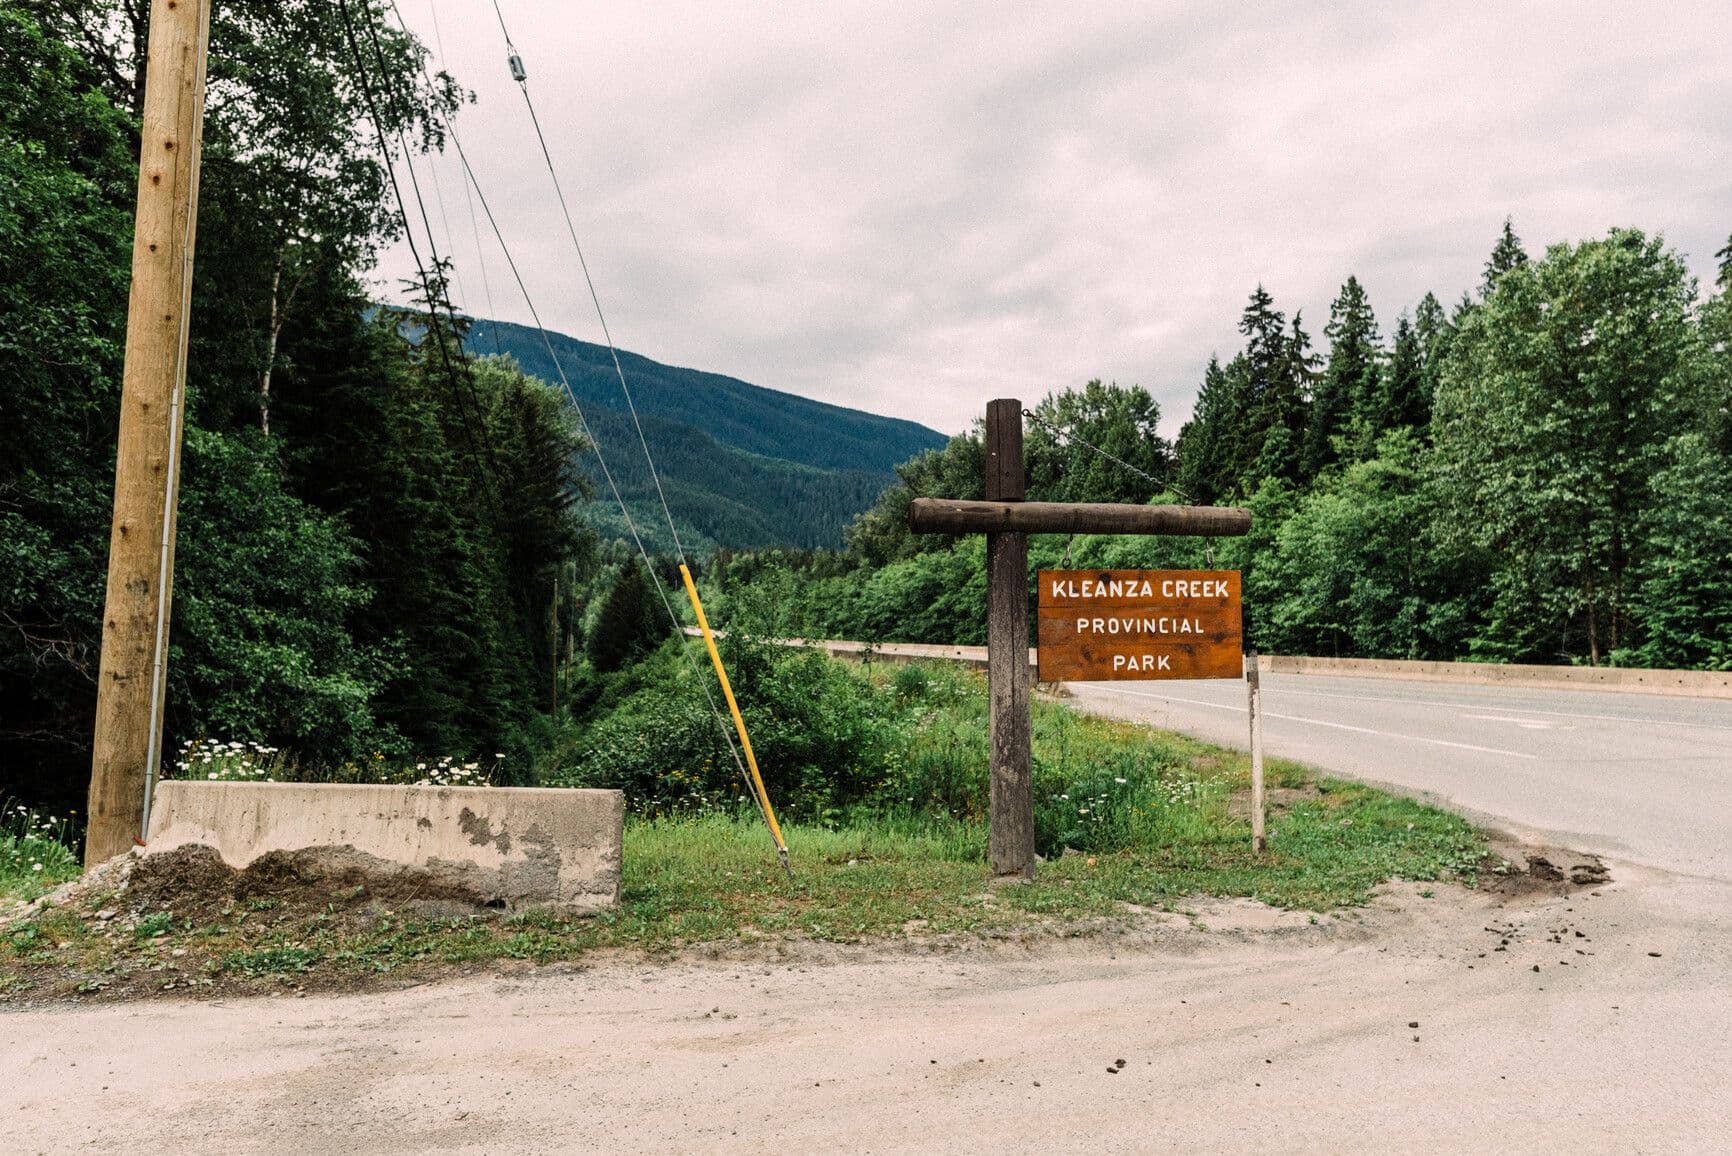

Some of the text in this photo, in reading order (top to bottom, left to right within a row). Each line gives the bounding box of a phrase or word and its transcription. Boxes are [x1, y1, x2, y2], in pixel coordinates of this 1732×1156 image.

[1052, 580, 1229, 598] KLEANZA CREEK
[1077, 617, 1204, 634] PROVINCIAL
[1113, 655, 1171, 671] PARK
